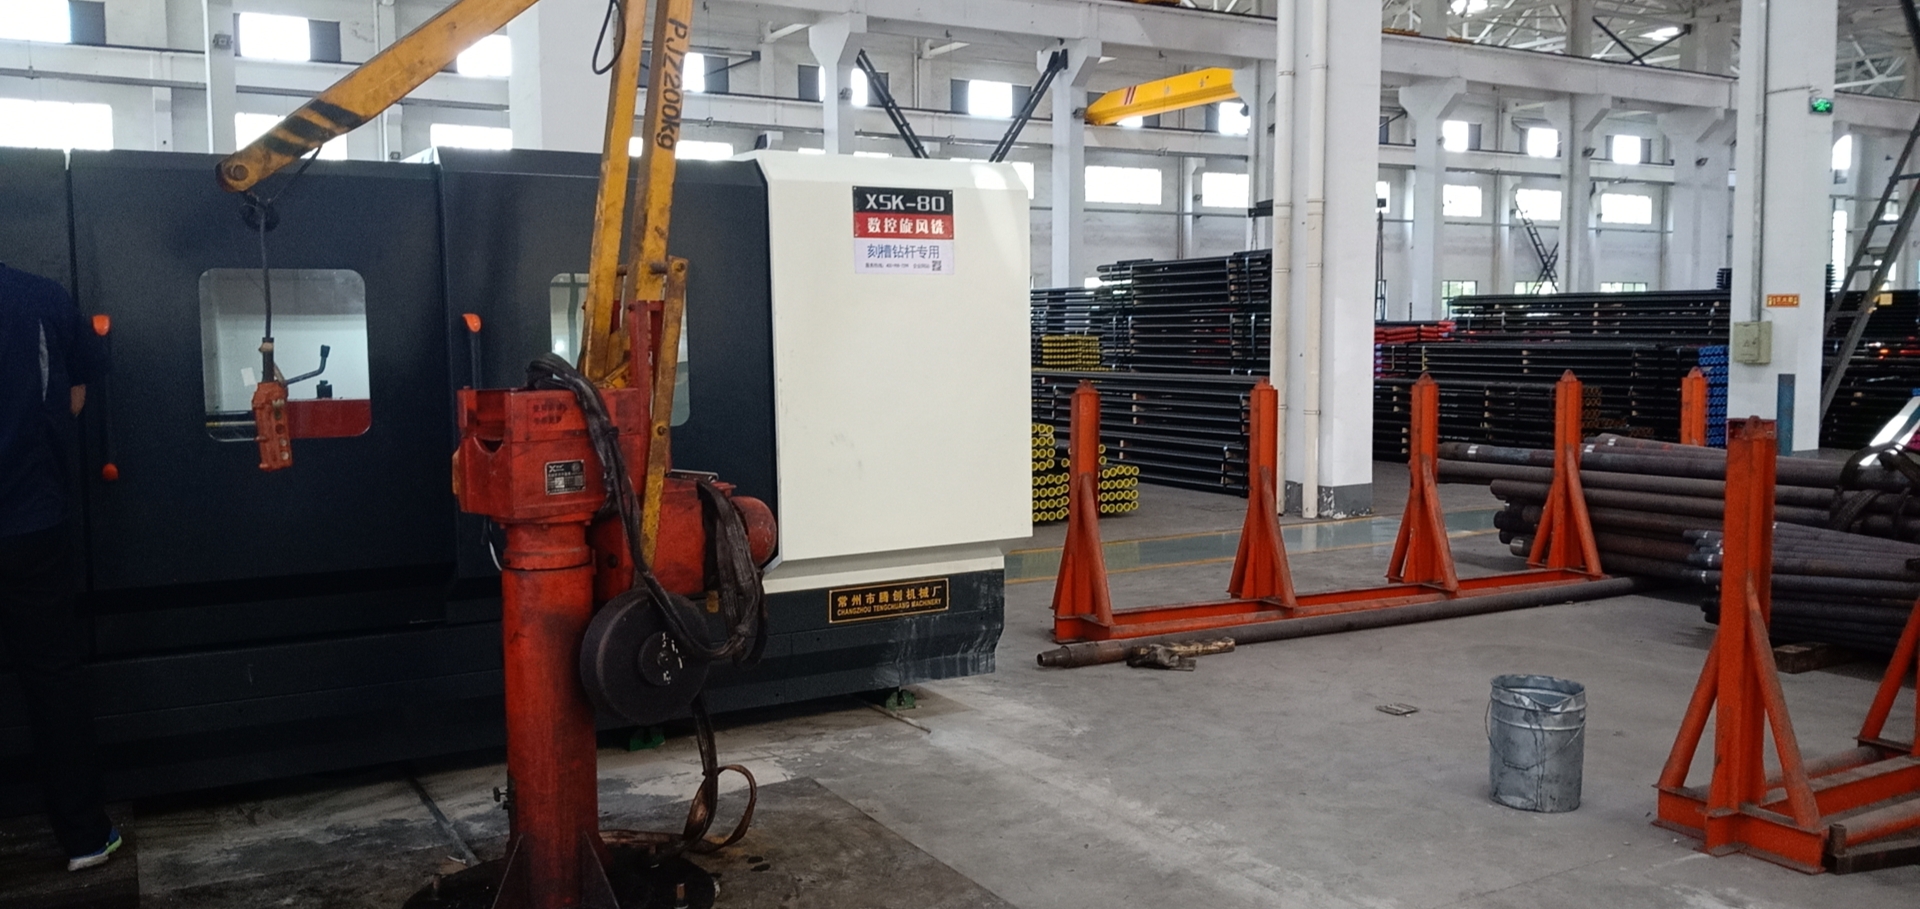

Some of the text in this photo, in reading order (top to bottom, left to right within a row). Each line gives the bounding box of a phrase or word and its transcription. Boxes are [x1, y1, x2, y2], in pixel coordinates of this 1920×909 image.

[865, 193, 944, 212] XSK-80
[867, 217, 944, 235] 数控旋风铣
[867, 243, 940, 259] 刻槽钻杆专用
[837, 606, 872, 616] CHANGZHOU
[911, 598, 942, 607] MACHINERY
